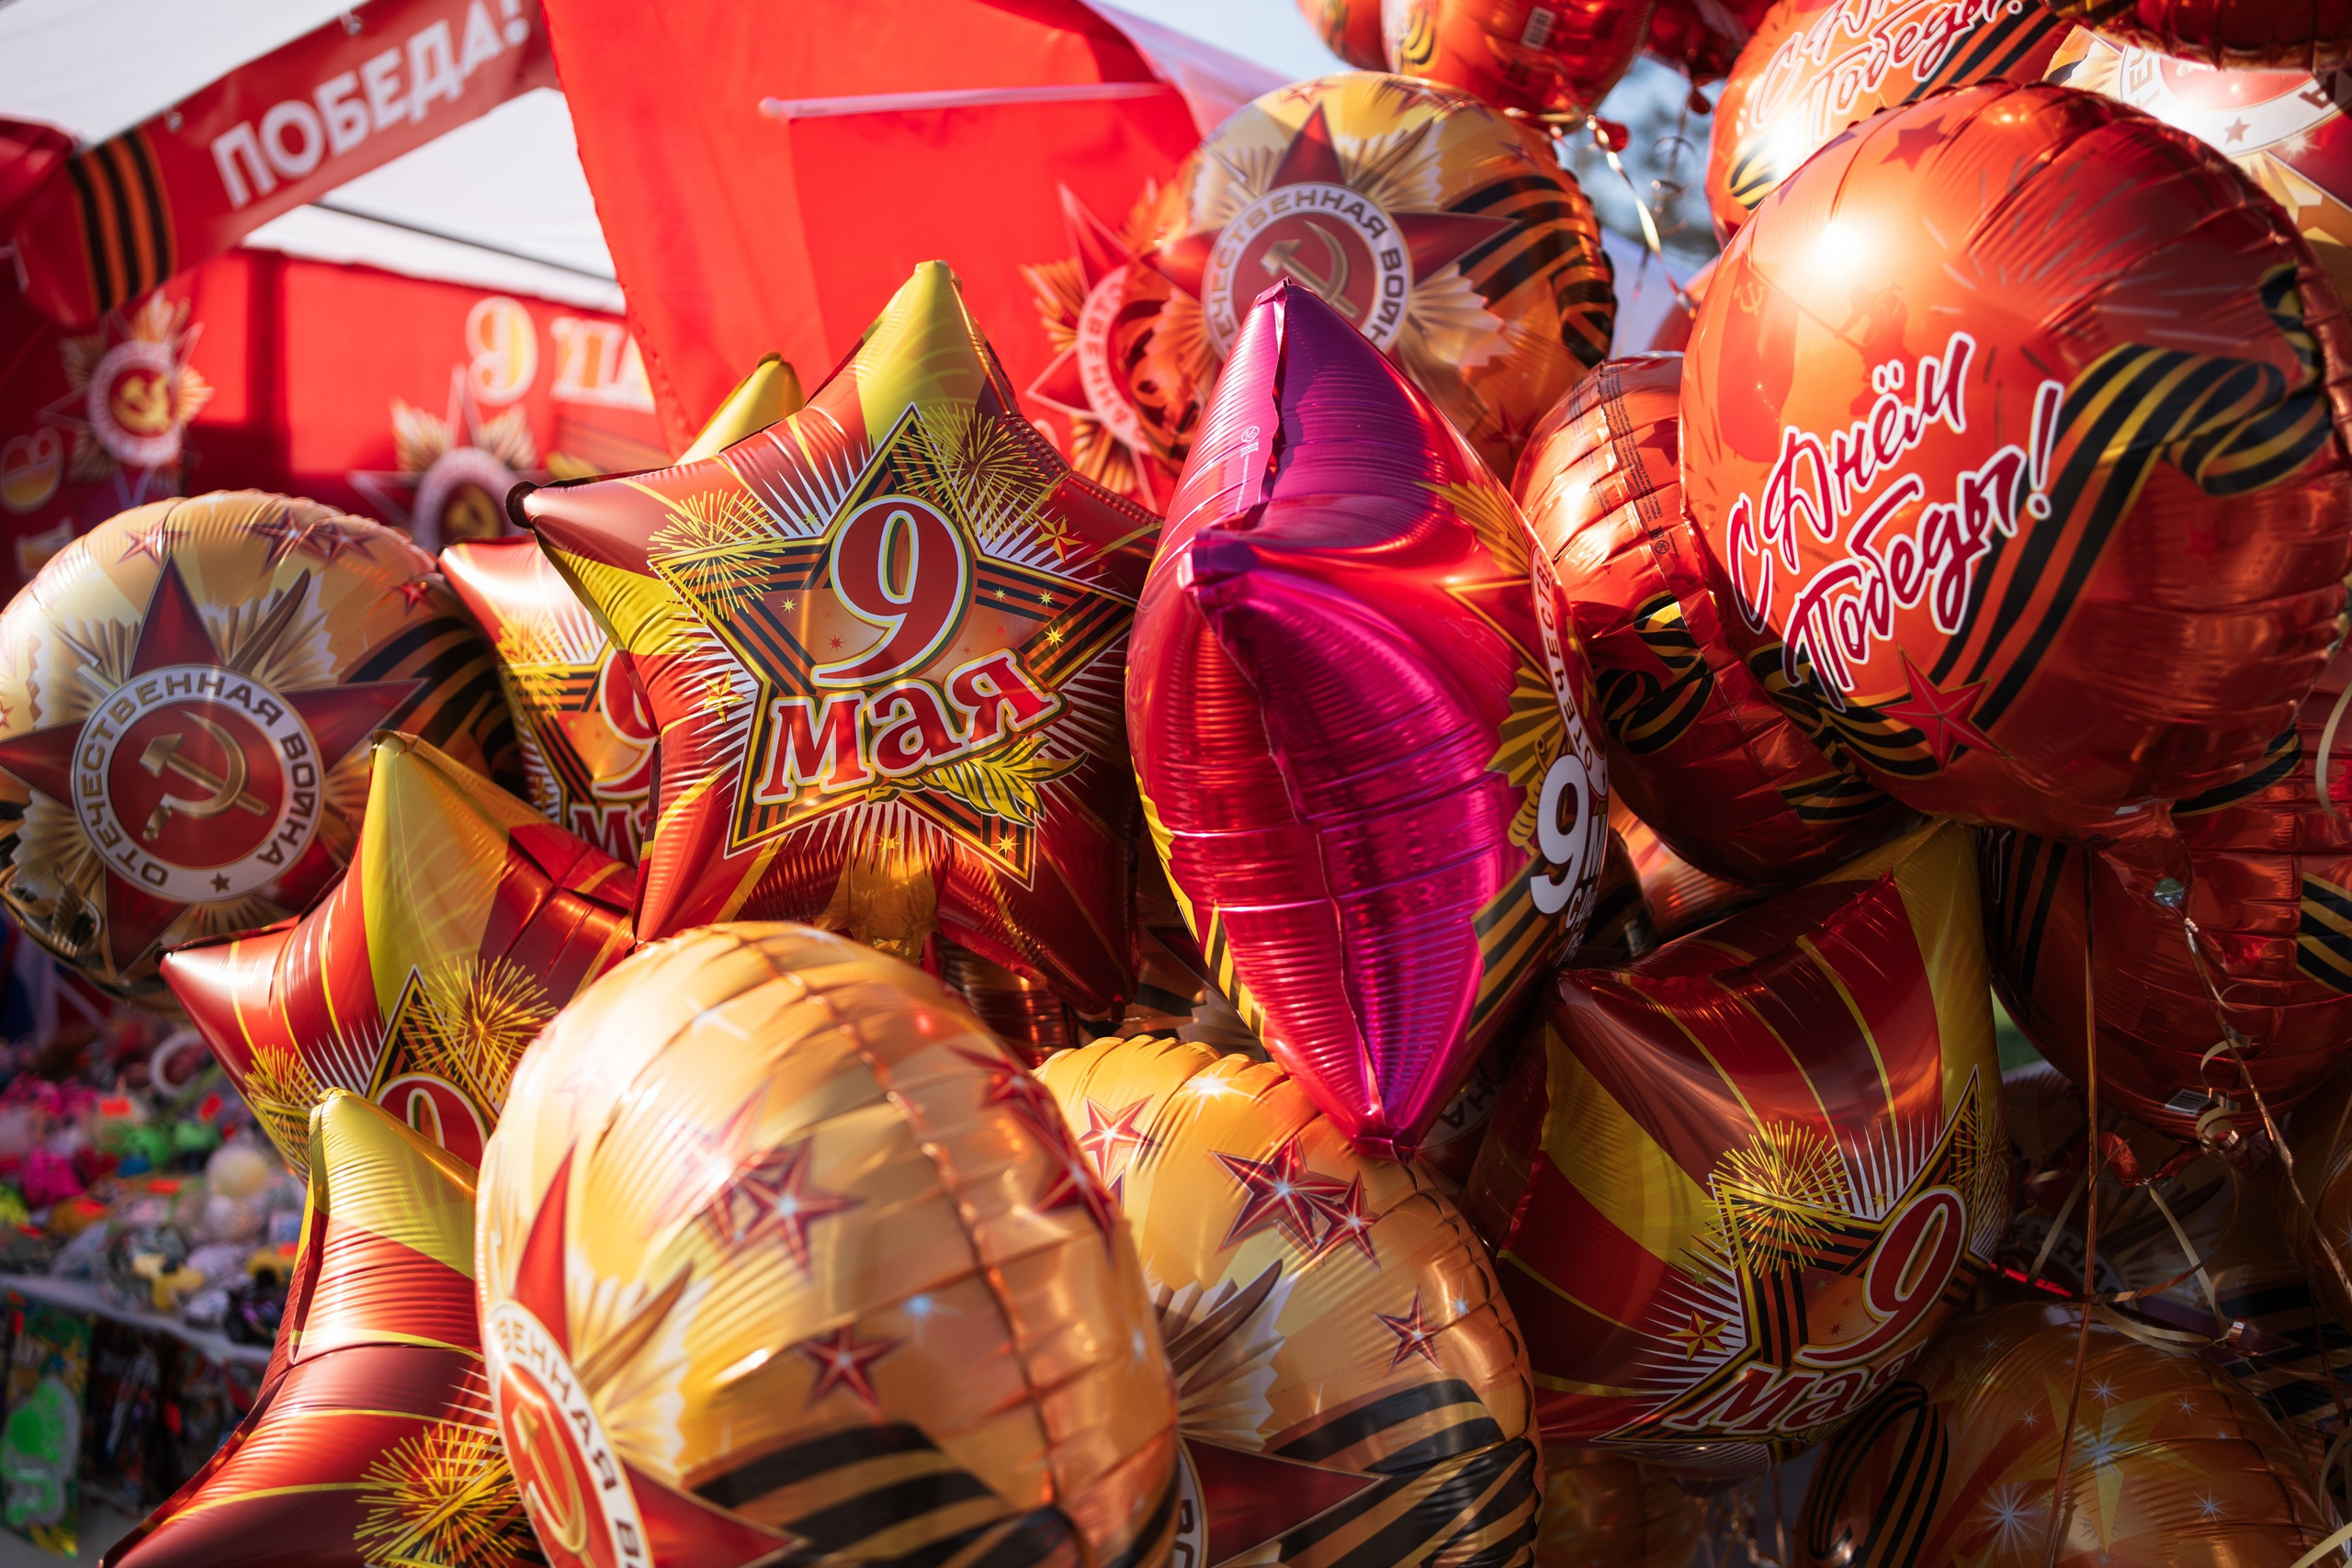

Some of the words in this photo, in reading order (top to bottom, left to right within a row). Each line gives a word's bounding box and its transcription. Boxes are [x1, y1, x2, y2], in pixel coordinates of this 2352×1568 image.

[210, 0, 530, 211] ПОБЕДА!
[465, 296, 538, 406] 9
[1726, 491, 1773, 634] С
[1759, 331, 1975, 575] Днём
[1781, 379, 2064, 713] Победы!
[810, 494, 972, 689] 9
[82, 671, 285, 887] ОТЕЧЕСТВЕННАЯ
[1530, 754, 1589, 915] 9
[1793, 1183, 1967, 1367] 9
